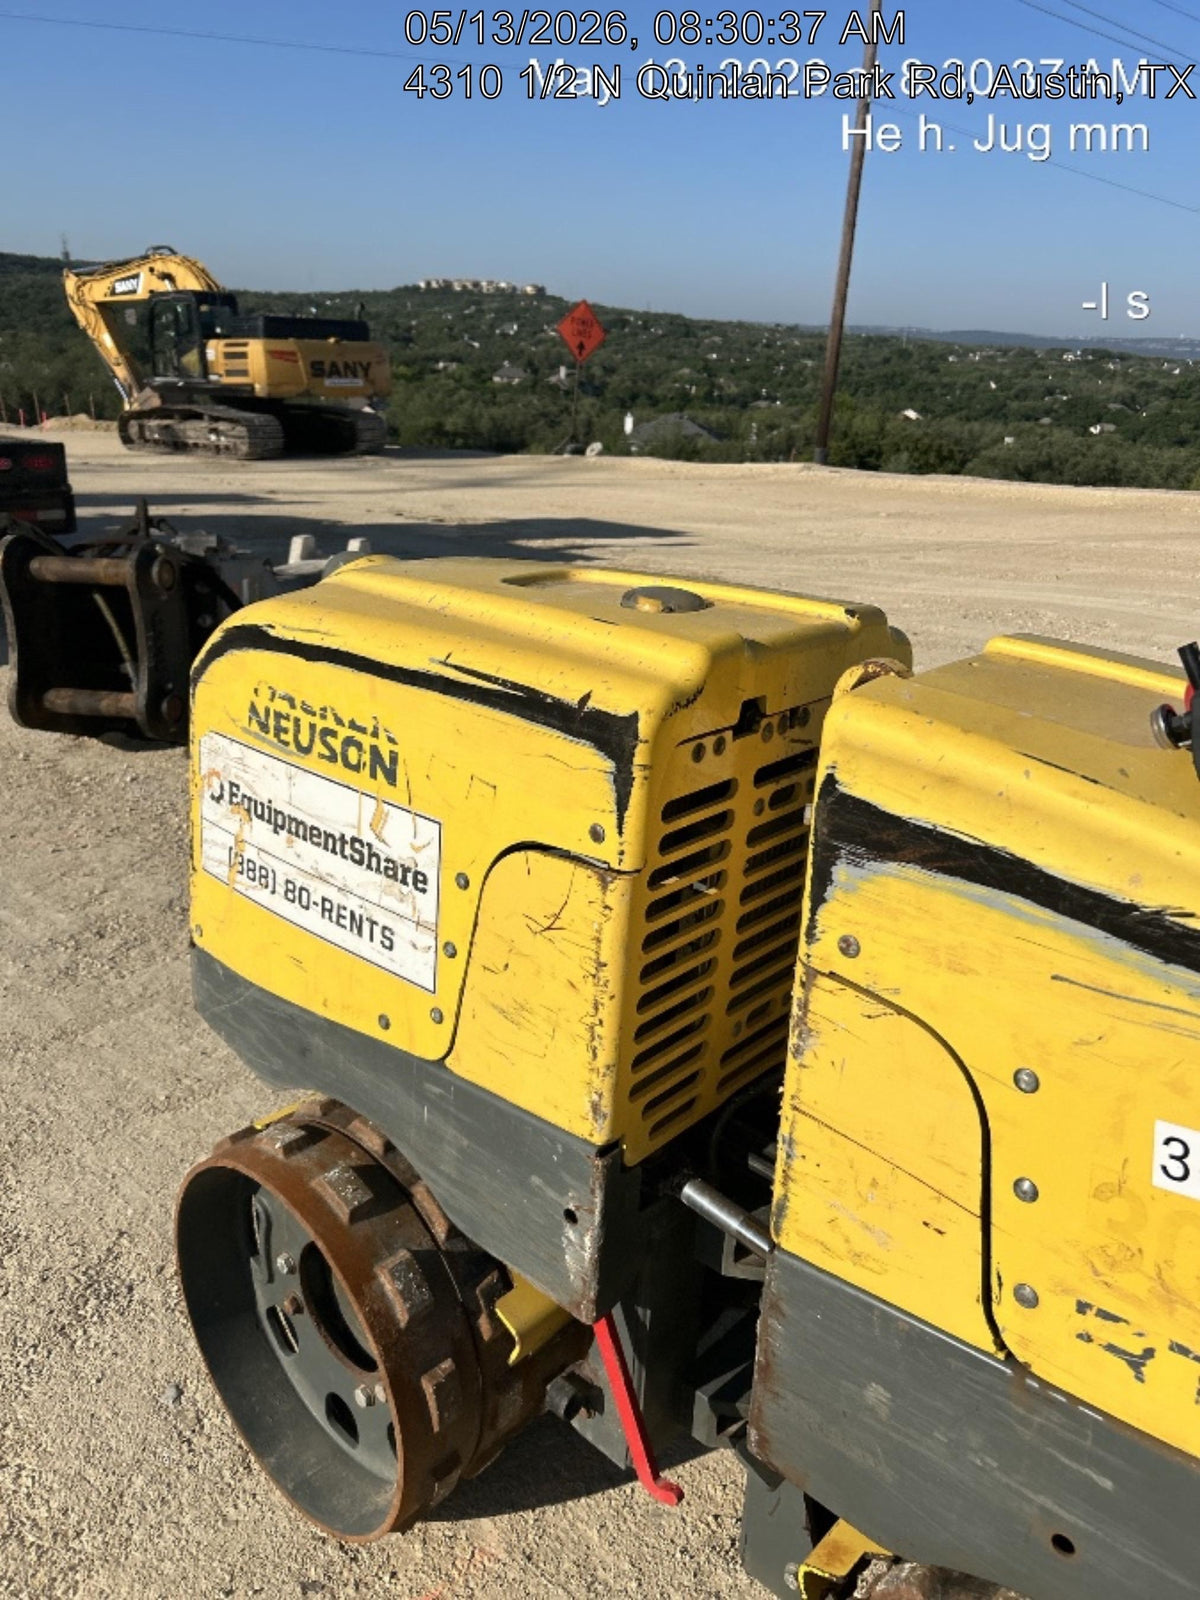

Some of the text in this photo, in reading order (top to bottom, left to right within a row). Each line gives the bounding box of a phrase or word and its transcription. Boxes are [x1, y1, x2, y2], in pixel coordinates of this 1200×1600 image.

[114, 277, 139, 294] SANY
[310, 360, 371, 378] SANY
[248, 701, 398, 787] NEUSON
[228, 780, 429, 895] EquipmentShare
[283, 877, 395, 952] 80-RENTS
